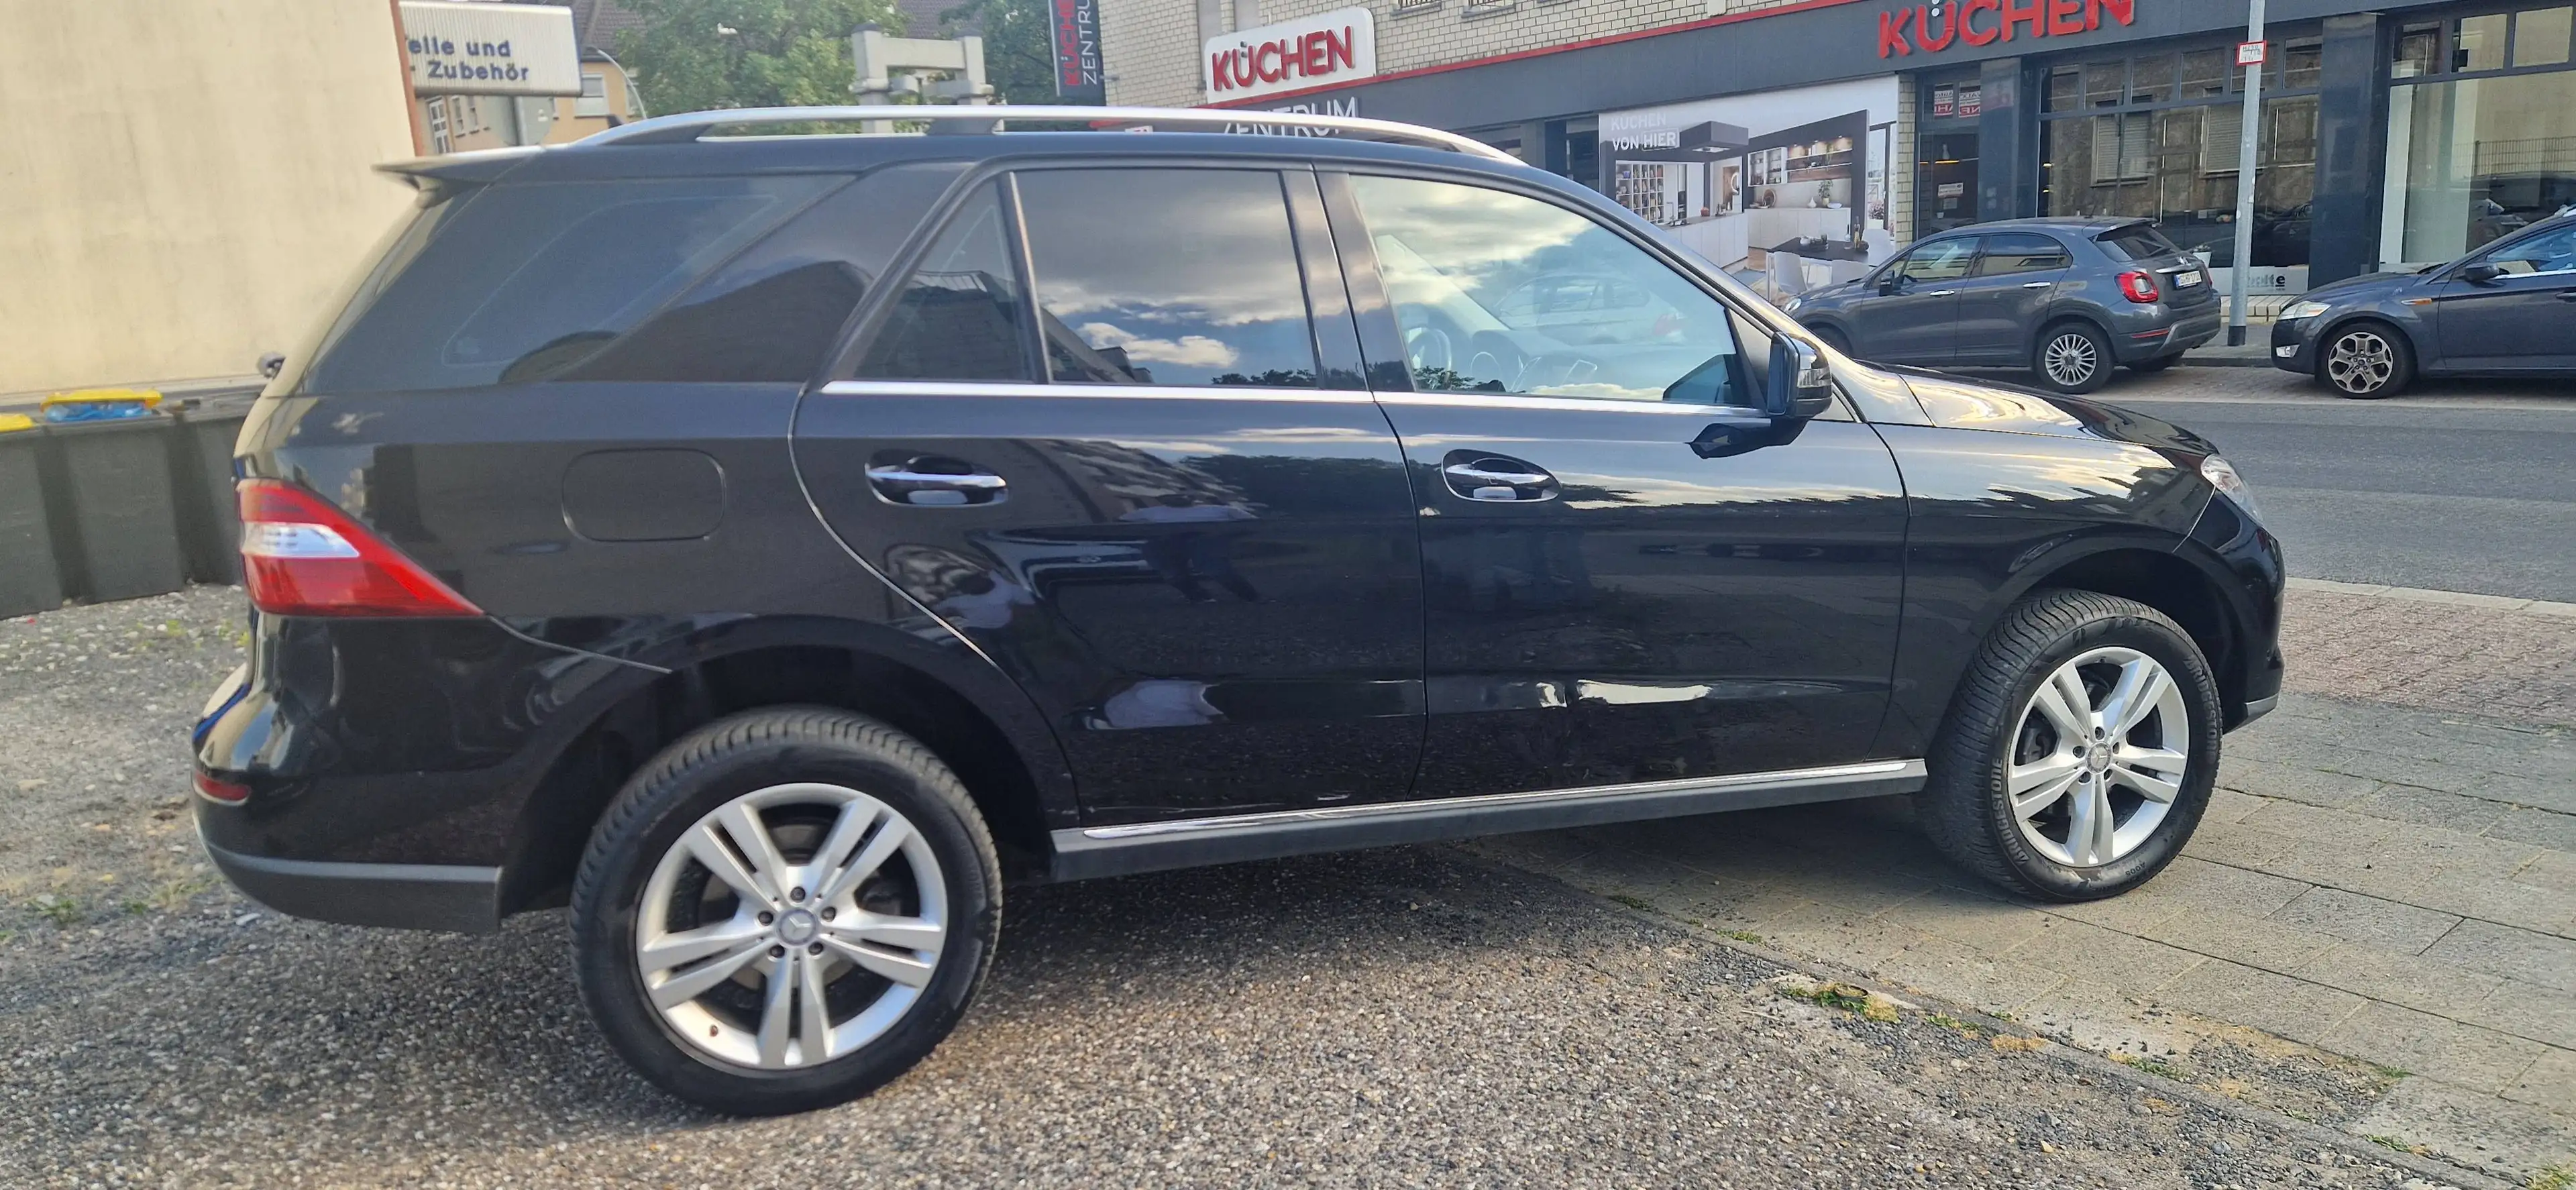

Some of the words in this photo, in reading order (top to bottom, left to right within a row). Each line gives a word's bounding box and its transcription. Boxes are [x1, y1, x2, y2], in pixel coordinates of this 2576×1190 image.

[466, 40, 511, 58] und
[1879, 0, 2135, 59] KÜCHEN
[427, 60, 529, 81] Zubehör
[1212, 25, 1354, 92] KÜCHEN
[1612, 135, 1639, 151] VON
[1644, 131, 1676, 148] HIER
[1990, 757, 2030, 867] BRIDGESTONE
